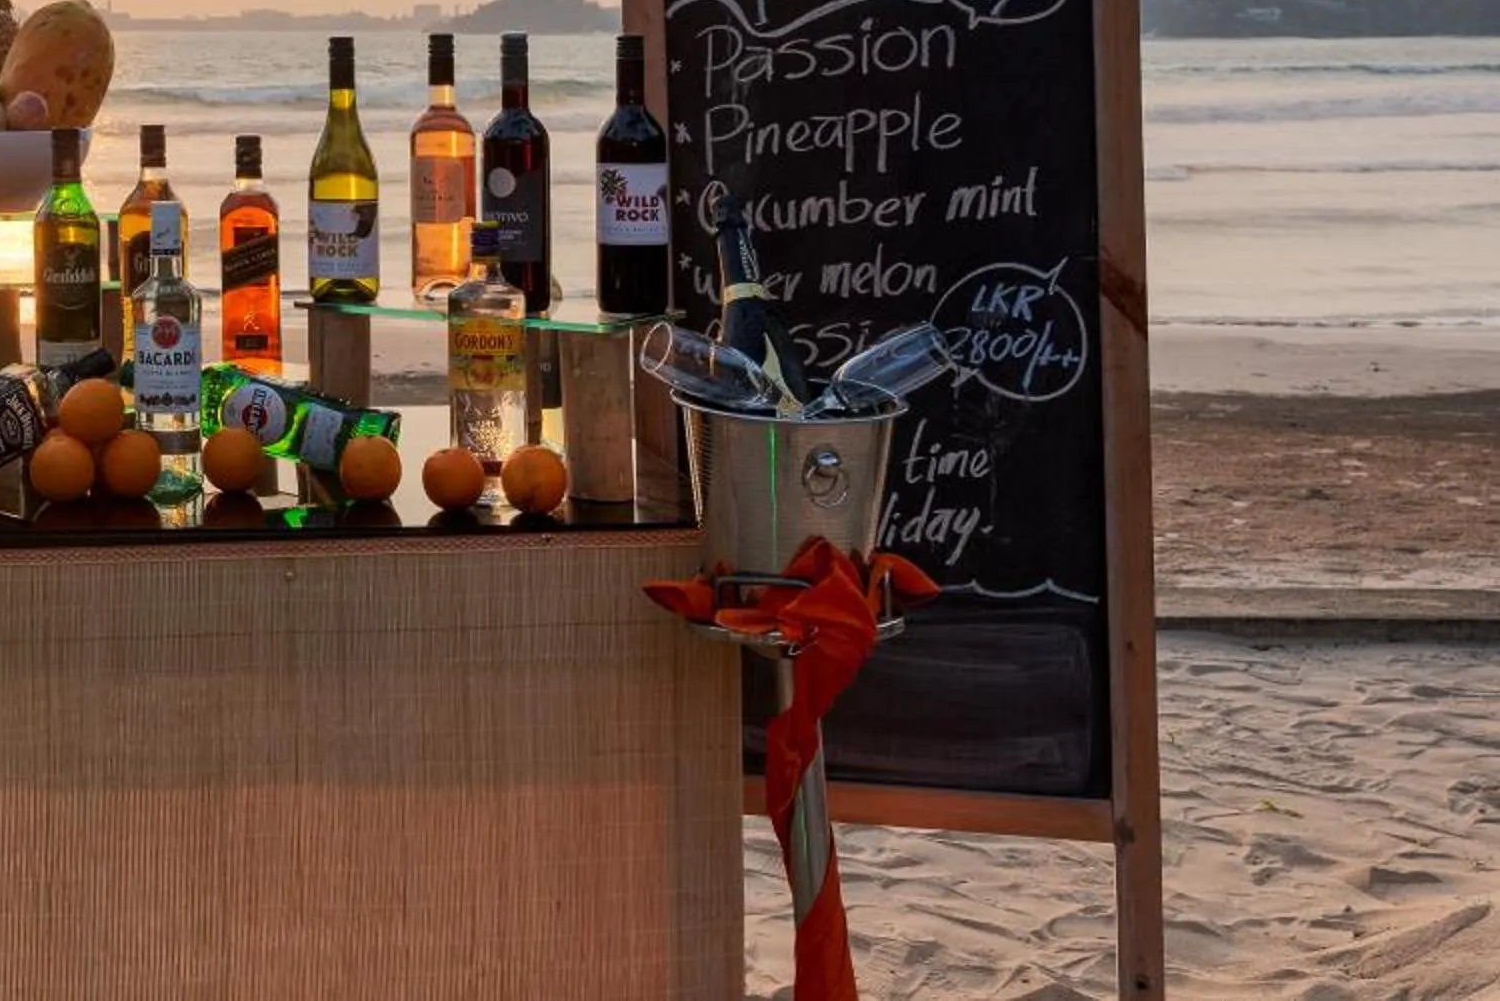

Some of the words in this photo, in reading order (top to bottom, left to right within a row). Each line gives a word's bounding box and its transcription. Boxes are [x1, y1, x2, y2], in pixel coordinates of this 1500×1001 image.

[696, 17, 956, 98] Passion
[705, 90, 963, 176] Pineapple
[615, 194, 660, 208] WILD
[615, 208, 660, 222] ROCK
[945, 166, 1038, 222] mint
[820, 242, 937, 299] melon
[971, 283, 1045, 322] LKR
[902, 418, 990, 484] time
